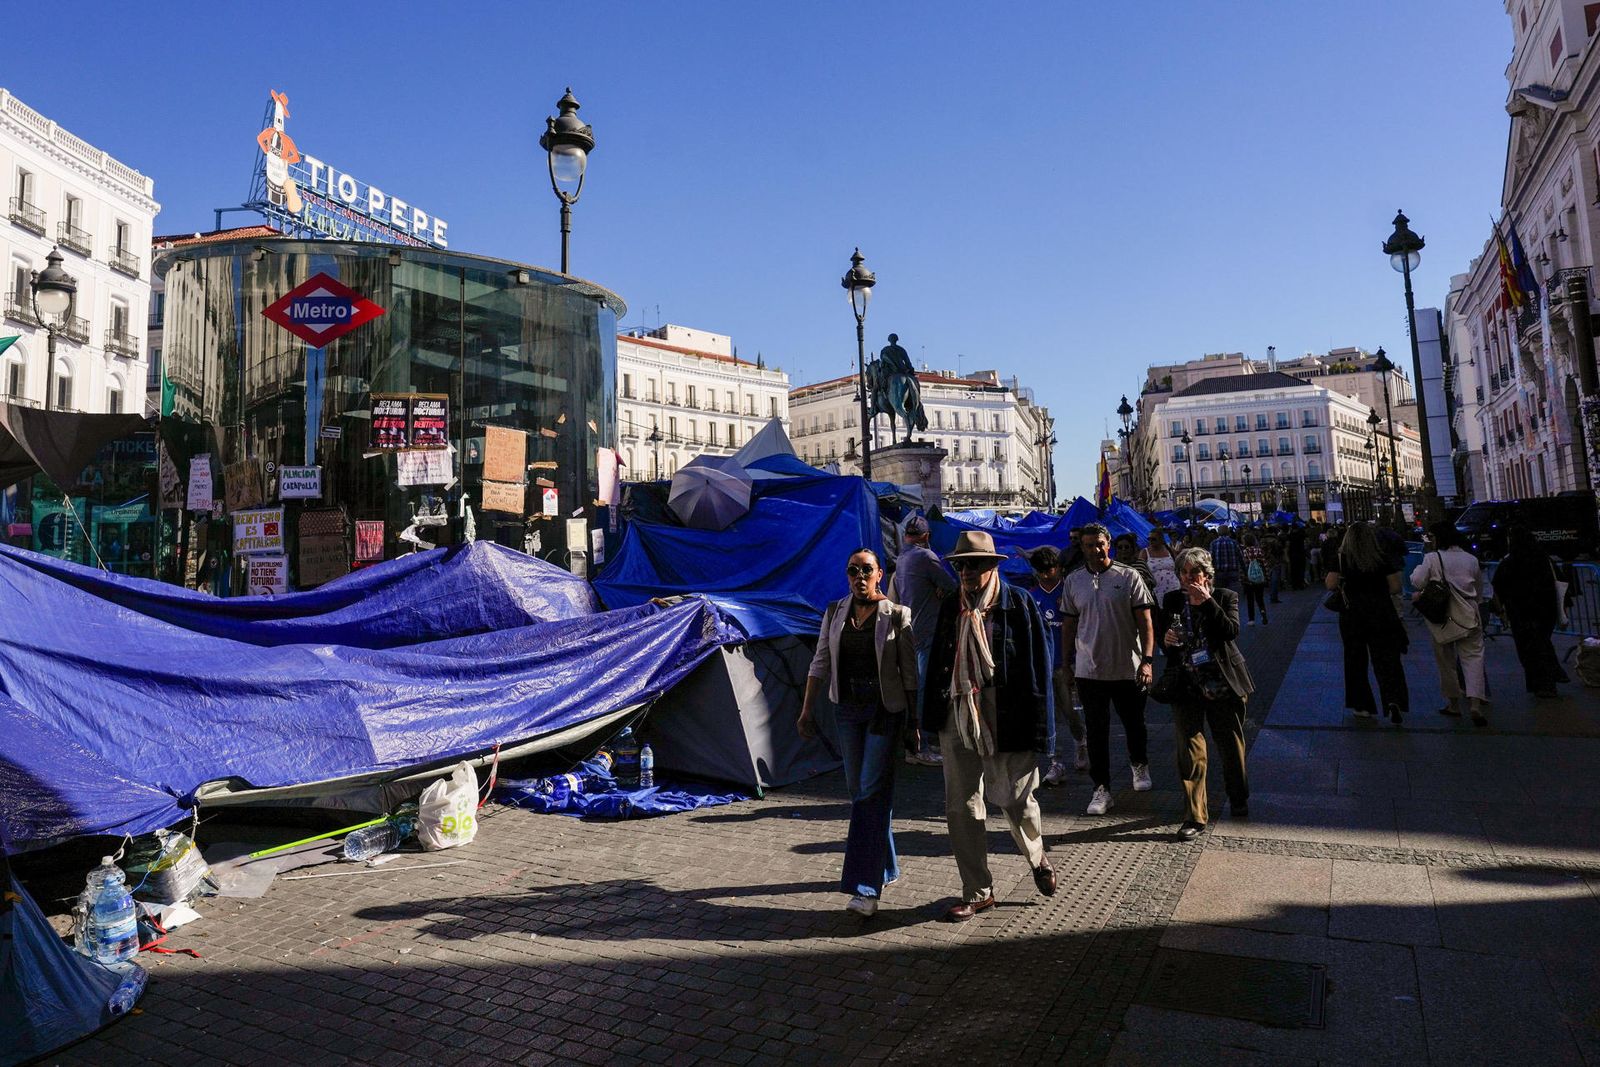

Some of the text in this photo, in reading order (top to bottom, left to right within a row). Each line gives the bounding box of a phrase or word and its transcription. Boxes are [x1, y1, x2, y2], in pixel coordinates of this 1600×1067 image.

[305, 154, 448, 248] TIO PEPE
[293, 302, 348, 319] Metro
[235, 511, 281, 525] RENTISMO
[245, 525, 258, 536] ES
[233, 536, 281, 551] CAPITALISMO
[250, 568, 277, 577] NO TIENE
[250, 577, 275, 586] FUTURO
